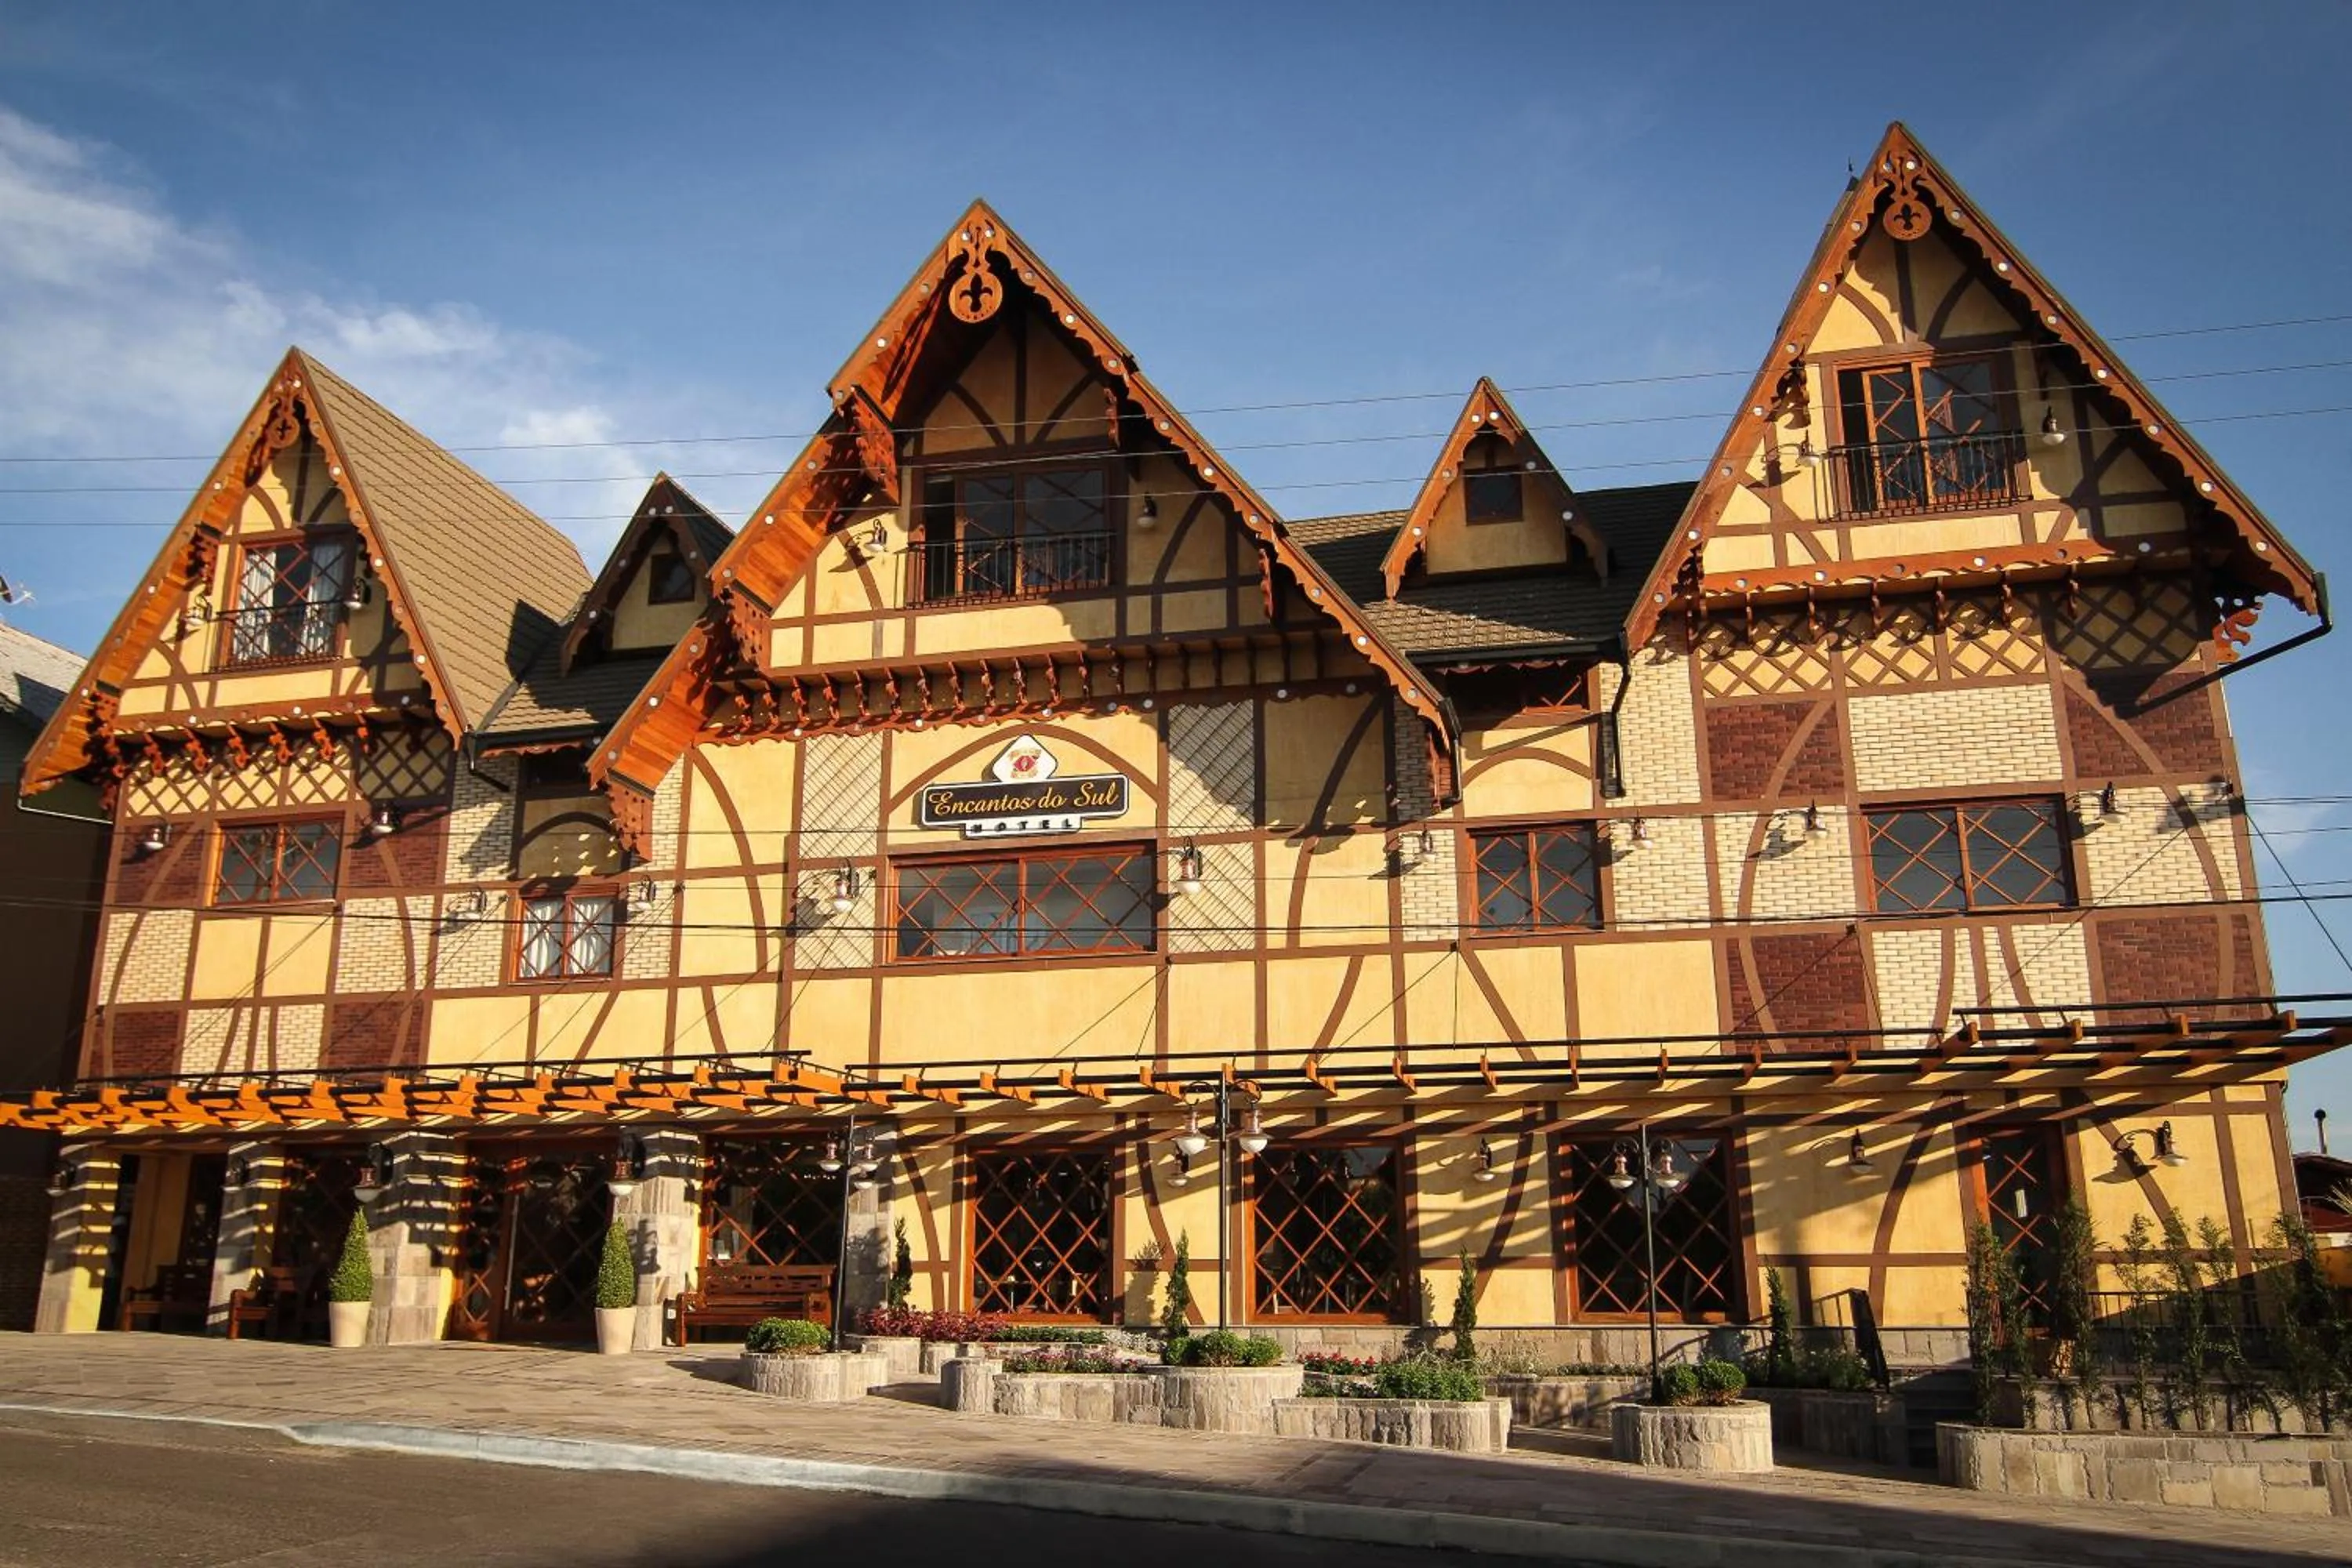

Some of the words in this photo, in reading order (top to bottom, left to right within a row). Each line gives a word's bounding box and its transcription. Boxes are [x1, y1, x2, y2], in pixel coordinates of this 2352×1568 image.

[928, 791, 1035, 815] Encantos
[1037, 786, 1067, 808] do
[1073, 782, 1120, 807] Sul
[971, 818, 1073, 833] HOTEL
